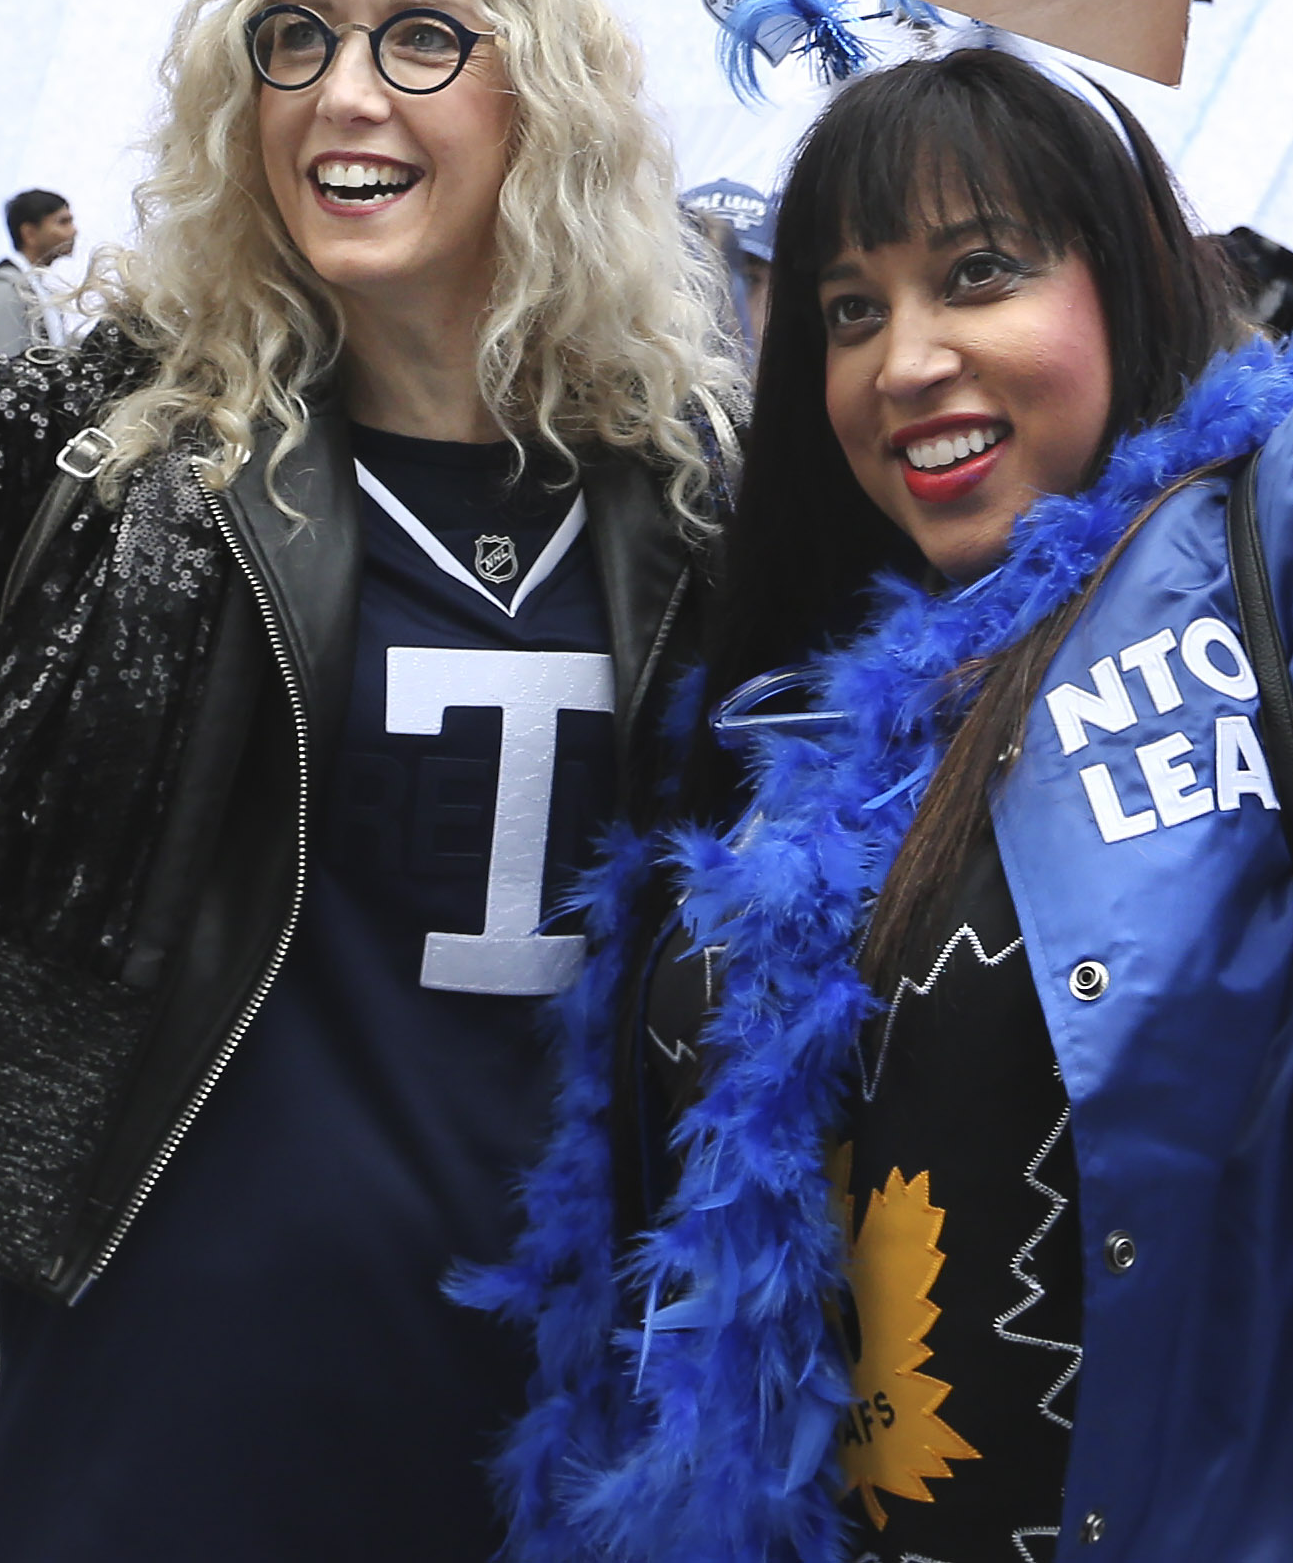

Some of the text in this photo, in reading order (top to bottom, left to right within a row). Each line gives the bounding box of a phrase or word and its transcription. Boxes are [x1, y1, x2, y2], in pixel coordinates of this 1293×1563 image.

[485, 548, 509, 571] NHL
[1045, 617, 1259, 757] NTO
[385, 646, 615, 996] T
[838, 1390, 896, 1446] AFS
